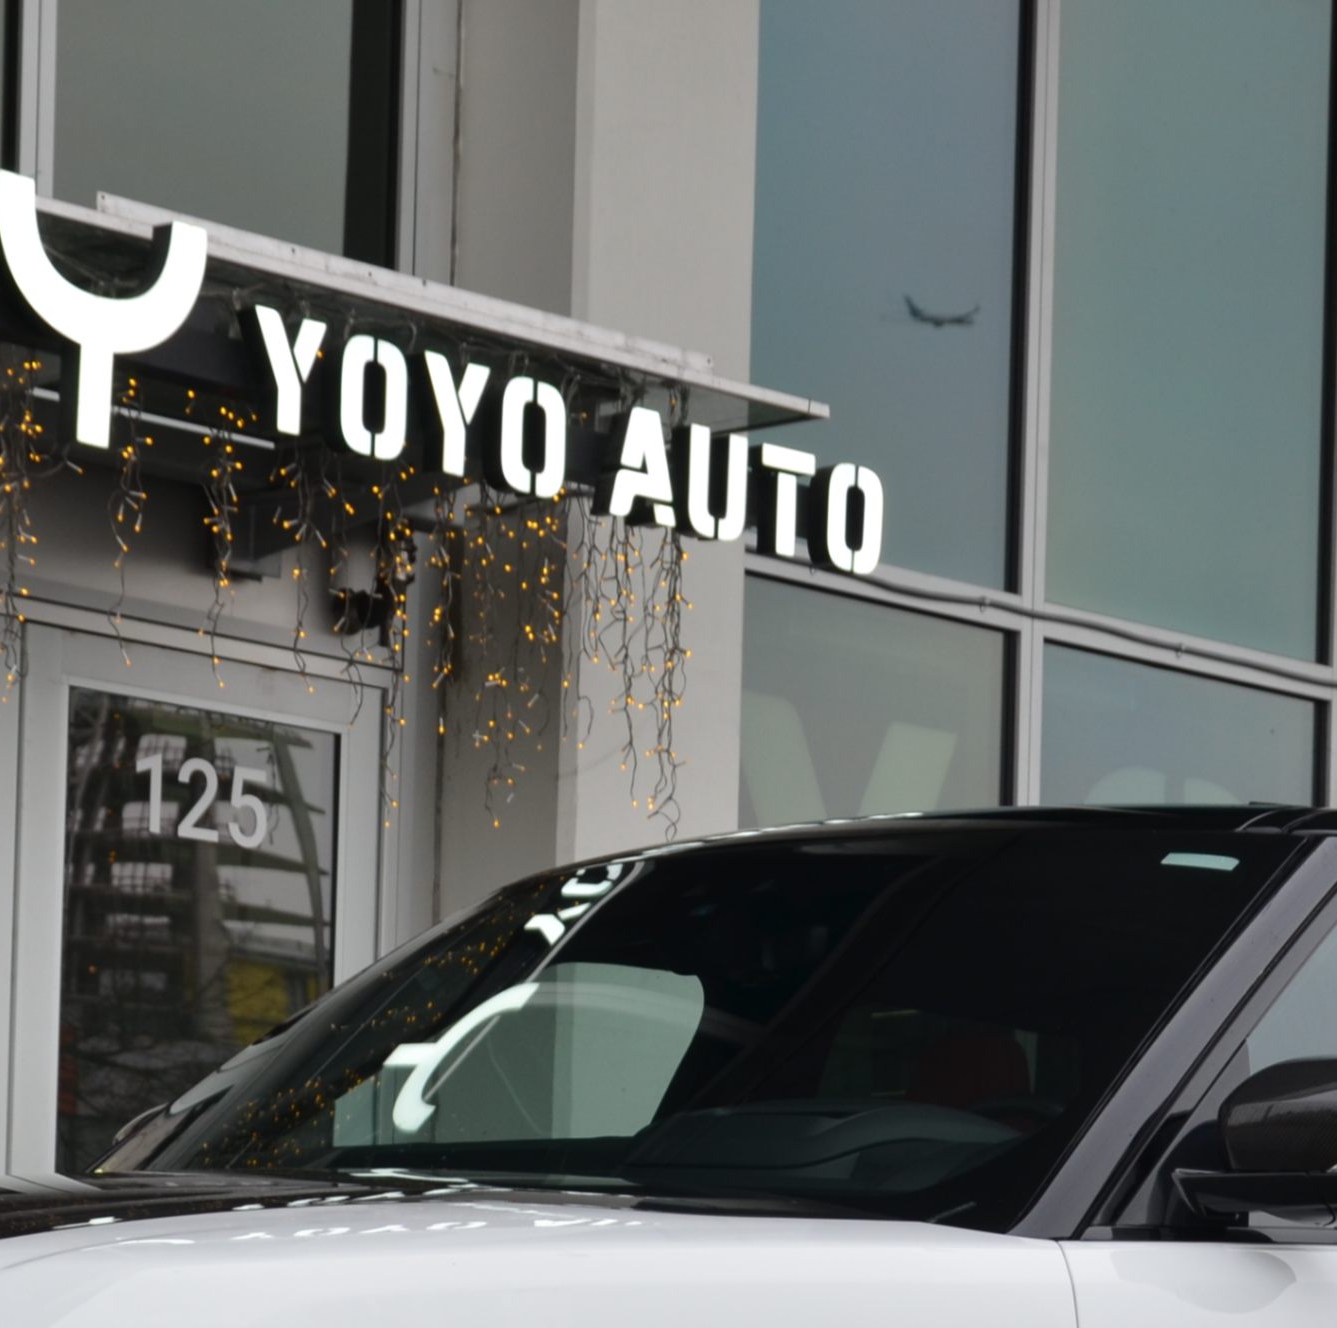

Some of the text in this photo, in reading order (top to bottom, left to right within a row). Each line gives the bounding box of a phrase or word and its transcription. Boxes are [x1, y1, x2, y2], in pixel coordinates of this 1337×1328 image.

[253, 303, 885, 575] YOYO AUTO
[136, 754, 269, 850] 125
